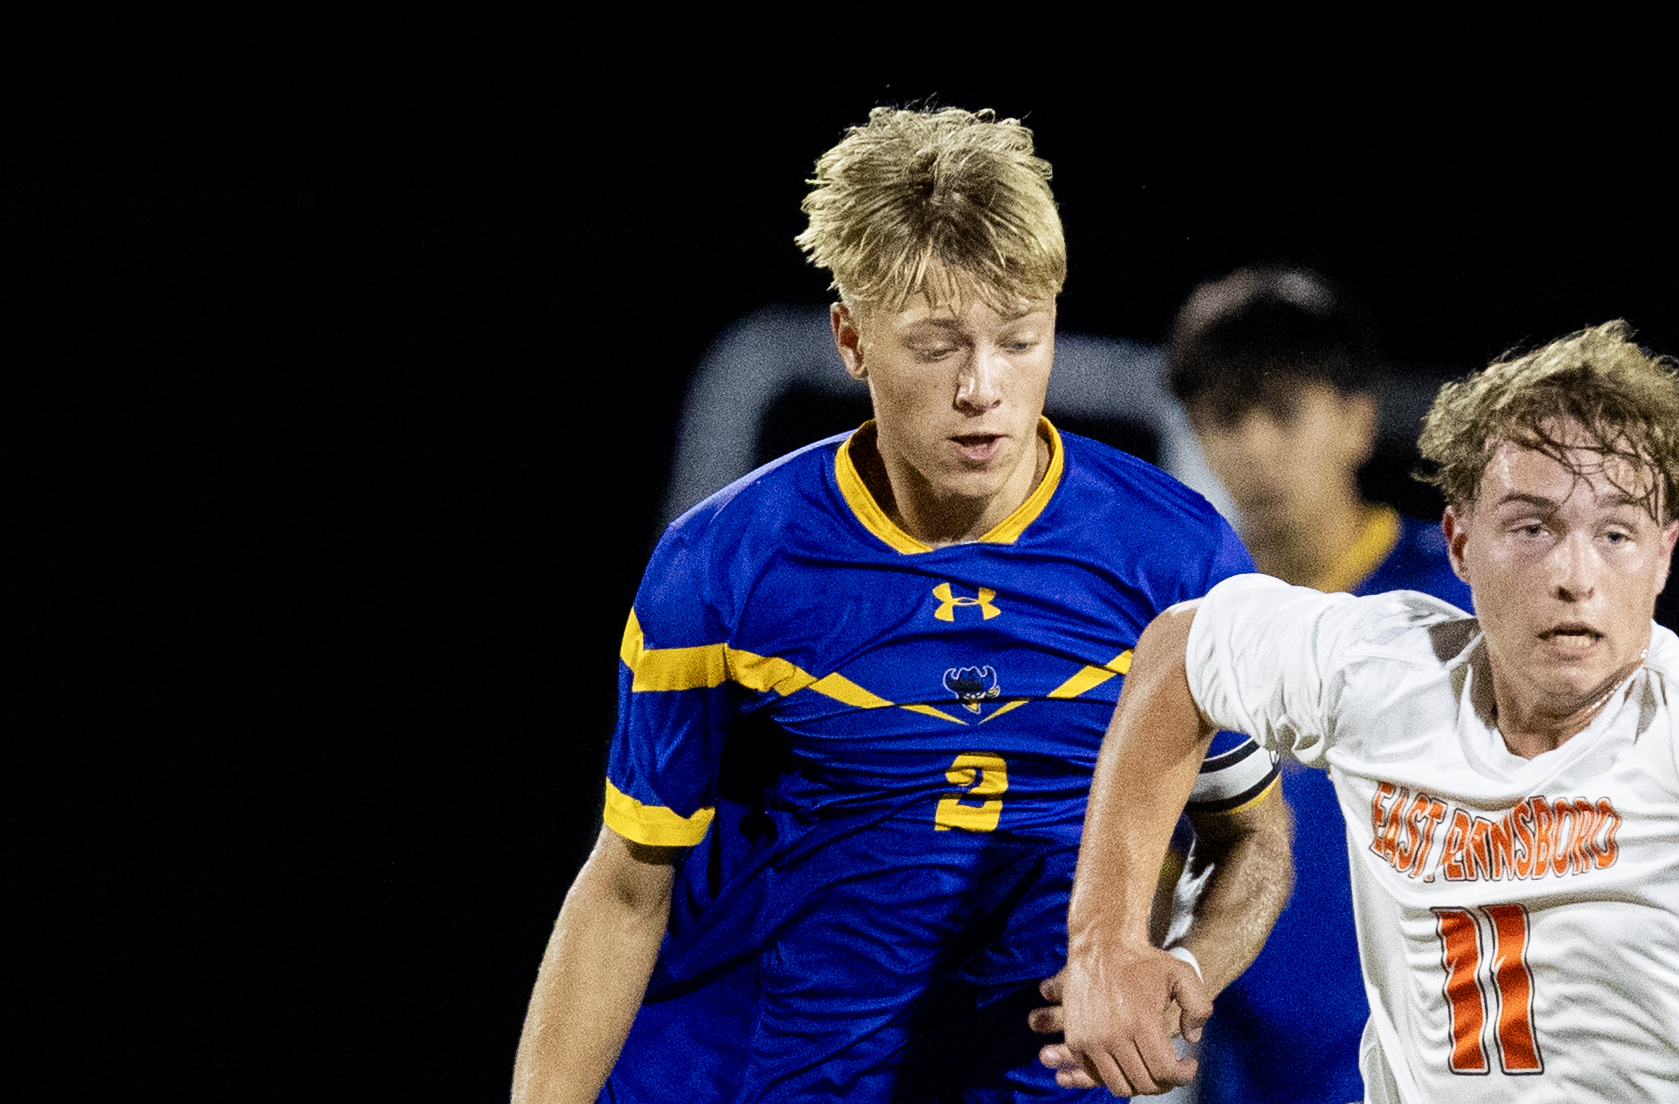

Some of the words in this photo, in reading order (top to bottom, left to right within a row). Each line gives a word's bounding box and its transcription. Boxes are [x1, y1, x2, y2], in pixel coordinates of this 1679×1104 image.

[934, 751, 1008, 833] 2
[1370, 780, 1448, 883] EAST
[1430, 903, 1544, 1075] 11
